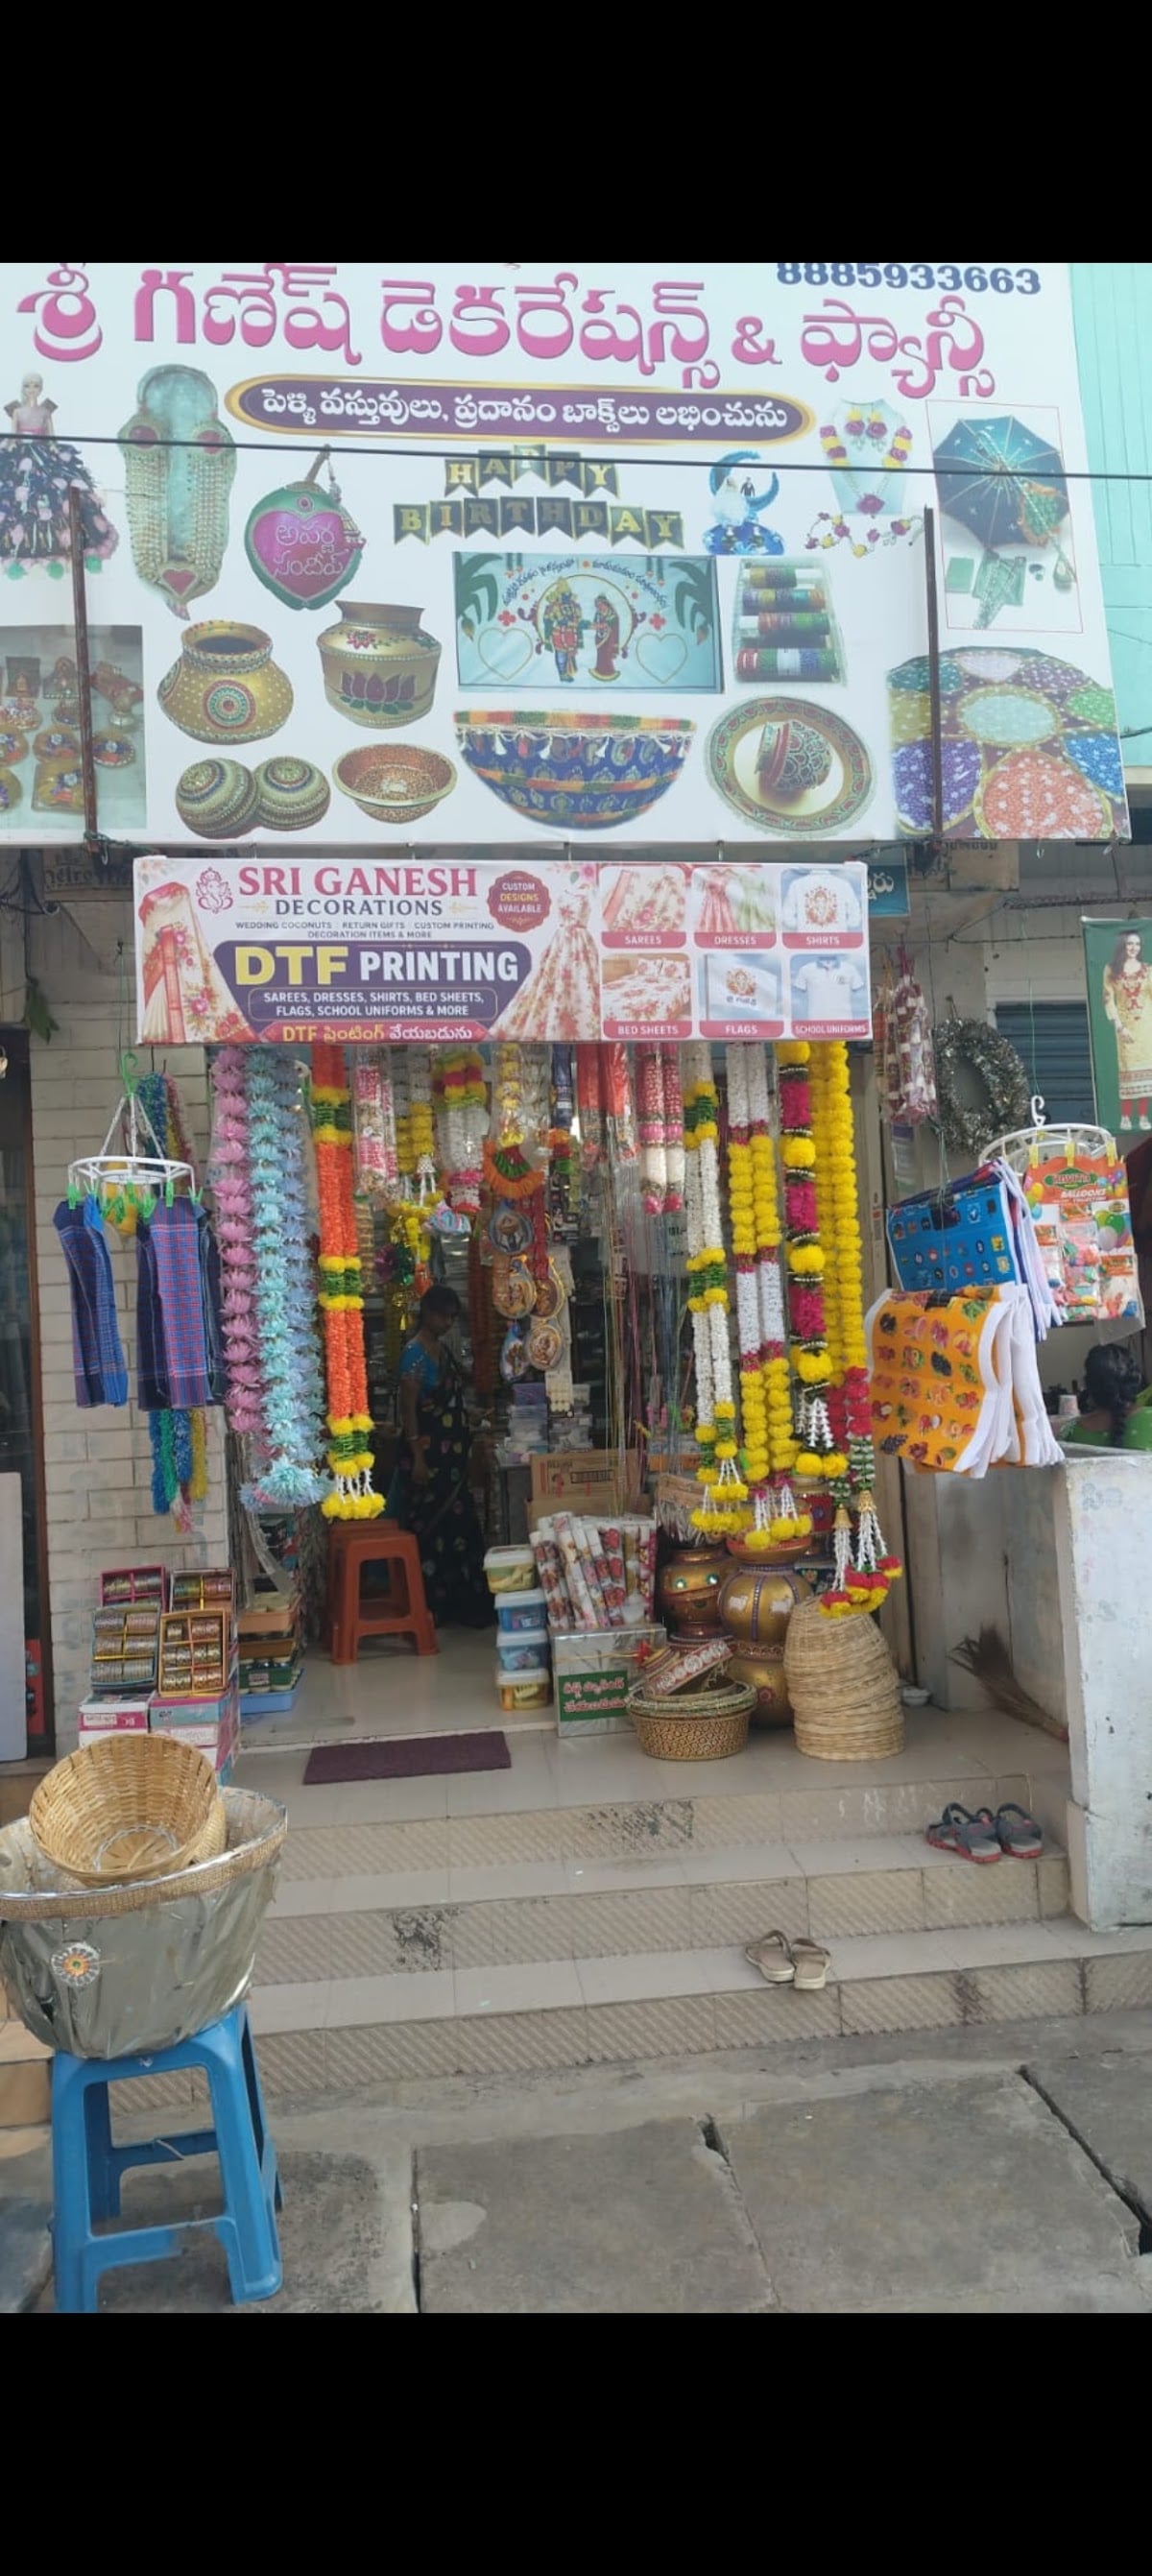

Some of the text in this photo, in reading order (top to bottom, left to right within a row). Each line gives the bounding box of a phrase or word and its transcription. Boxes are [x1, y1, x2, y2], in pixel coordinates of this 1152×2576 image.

[777, 263, 1042, 295] 8885933663
[16, 263, 104, 362] శ్రీ
[133, 263, 363, 365] గణేష్
[380, 271, 721, 389] డెకరేషన్స్
[731, 316, 782, 365] &
[454, 393, 557, 428] ప్రదానం
[656, 401, 788, 431] లభించును
[448, 448, 612, 486] HAPPY
[399, 500, 679, 538] BIRTHDAY
[239, 866, 477, 898] SRI GANESH
[502, 882, 535, 891] CUSTOM
[500, 893, 539, 903] DESIGNS
[276, 899, 443, 916] DECORATIONS
[498, 903, 541, 913] AVAILABLE
[342, 922, 378, 930] RETURN
[415, 922, 451, 930] CUSTOM
[453, 922, 495, 930] PRINTING
[307, 930, 367, 939] DECORATION
[369, 930, 396, 939] ITEMS
[407, 930, 432, 939] MORE
[625, 936, 662, 946] SAREES
[714, 936, 756, 946] DRESSES
[805, 936, 840, 946] SHIRTS
[234, 946, 519, 986] DTF PRINTING
[263, 992, 485, 1004] SAREES, DRESSES, SHIRTS, BED SHEETS,
[276, 1005, 469, 1018] FLAGS, SCHOOL UNIFORMS & MORE
[282, 1025, 318, 1042] DTF
[617, 1024, 679, 1035] BED SHEETS
[726, 1024, 758, 1035] FLAGS
